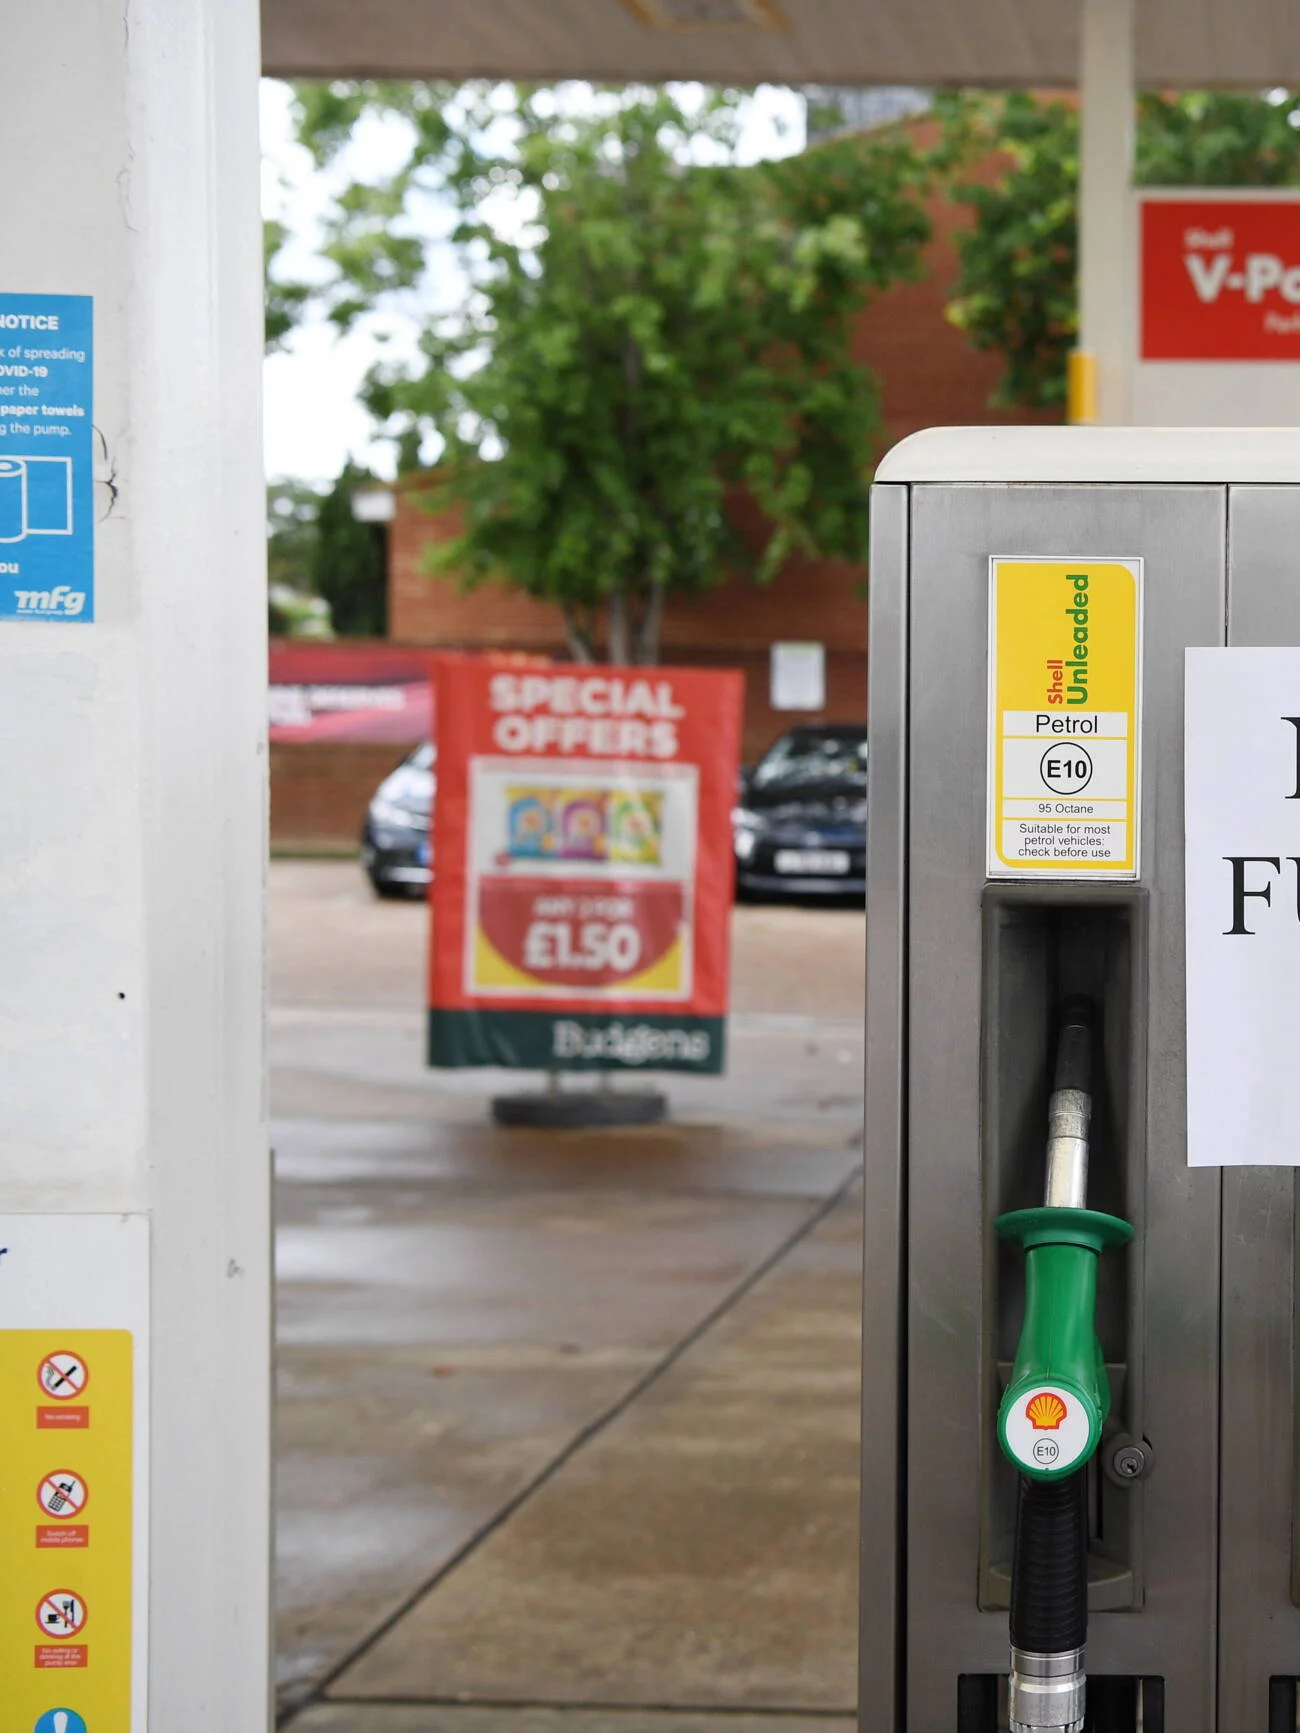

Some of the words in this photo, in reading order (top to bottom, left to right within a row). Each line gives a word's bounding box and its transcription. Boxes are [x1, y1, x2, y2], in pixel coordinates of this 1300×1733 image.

[8, 345, 21, 358] of
[24, 347, 86, 363] spreading
[19, 384, 39, 397] the
[1, 404, 39, 417] paper
[41, 403, 85, 417] towels
[10, 422, 30, 434] the
[33, 424, 72, 437] pump.
[14, 586, 86, 615] mfg
[1065, 574, 1088, 704] Unleaded
[1047, 659, 1063, 704] Shell
[489, 673, 686, 719] SPECIAL
[1036, 714, 1098, 734] Petrol
[492, 714, 679, 759] OFFERS
[1047, 760, 1087, 779] E10
[1038, 803, 1052, 813] 95
[1055, 803, 1094, 814] Octane
[1019, 823, 1063, 834] Suitable
[1066, 823, 1081, 834] for
[1084, 825, 1111, 834] most
[1024, 836, 1055, 848] petrol
[1018, 847, 1050, 857] check
[1053, 847, 1088, 857] before
[1091, 848, 1111, 857] use
[522, 920, 641, 973] £1.50
[552, 1019, 711, 1065] Budgens
[1037, 1446, 1056, 1457] E10
